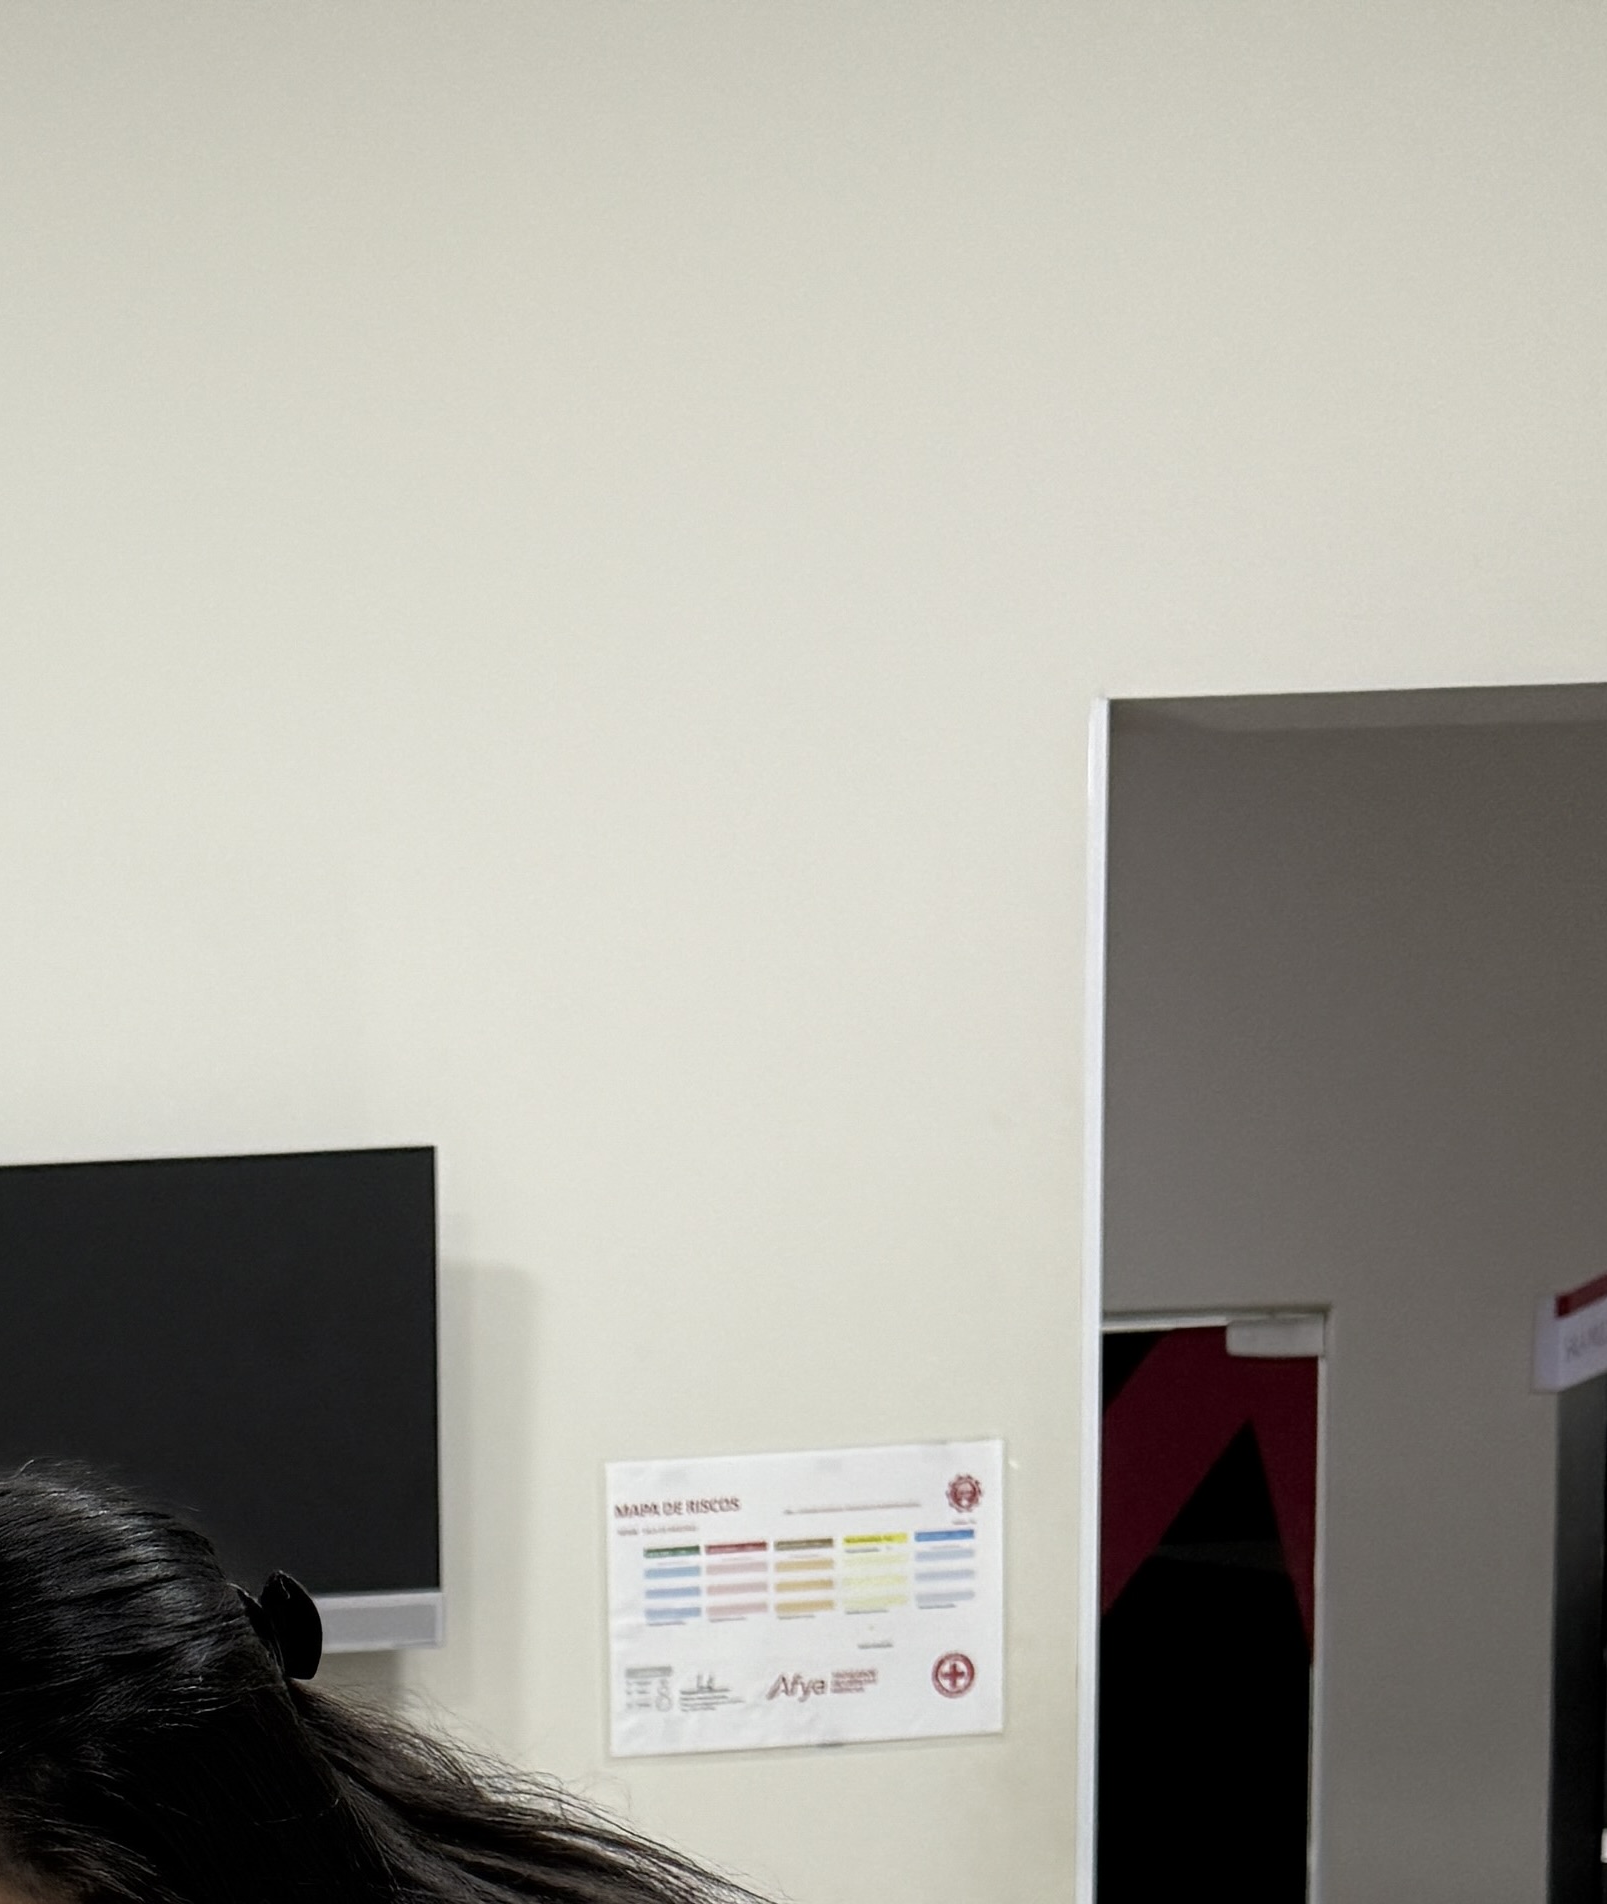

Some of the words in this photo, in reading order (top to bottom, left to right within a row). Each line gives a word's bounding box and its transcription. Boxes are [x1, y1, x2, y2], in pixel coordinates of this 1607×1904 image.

[614, 1503, 659, 1518] MAPA
[662, 1500, 683, 1515] DE
[686, 1496, 741, 1513] RISCOS
